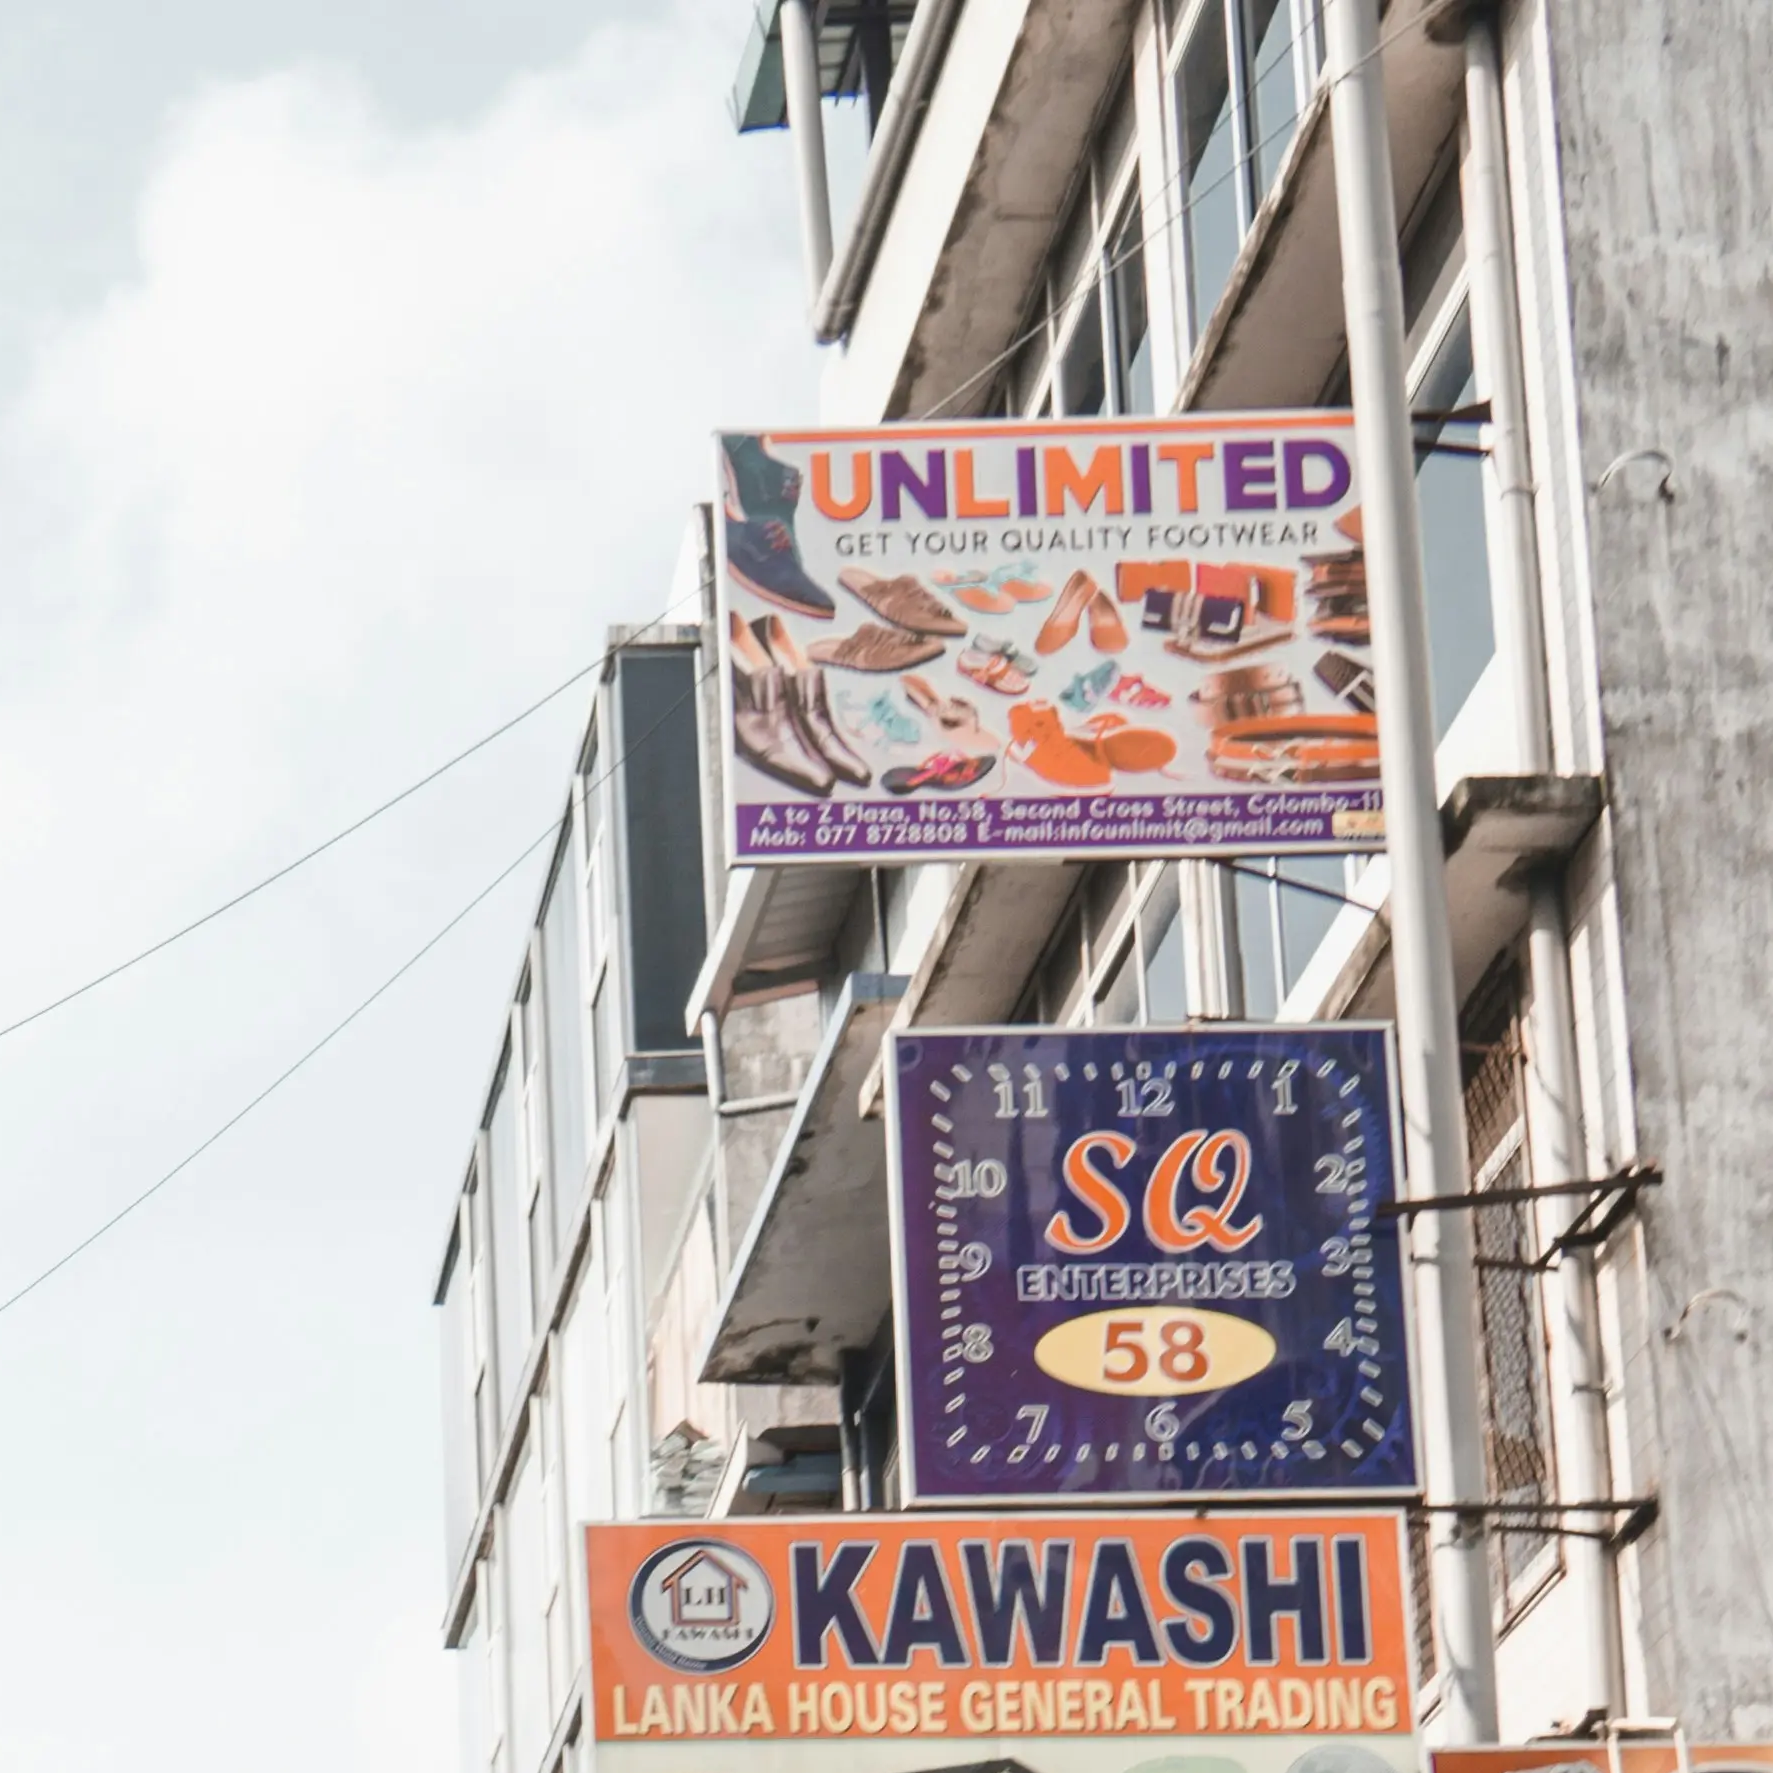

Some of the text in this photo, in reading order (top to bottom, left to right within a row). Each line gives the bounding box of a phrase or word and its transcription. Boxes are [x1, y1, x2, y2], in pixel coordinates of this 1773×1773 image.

[810, 439, 1352, 521] UNLIMITED
[835, 519, 1319, 558] GET YOUR QUALITY FOOTWEAR
[999, 798, 1081, 821] Second
[1089, 796, 1155, 819] Cross
[993, 1074, 1298, 1119] 11 12 1
[952, 1158, 1008, 1199] 10
[1044, 1129, 1263, 1254] SQ
[959, 1242, 993, 1282] 9
[1017, 1261, 1296, 1302] ENTERPRISES
[962, 1322, 994, 1363] 8
[1102, 1318, 1210, 1385] 58
[1016, 1399, 1313, 1443] 7 6 5
[789, 1533, 1373, 1670] KAWASHI
[613, 1675, 1399, 1738] LANKA HOUSE GENERAL TRADING
